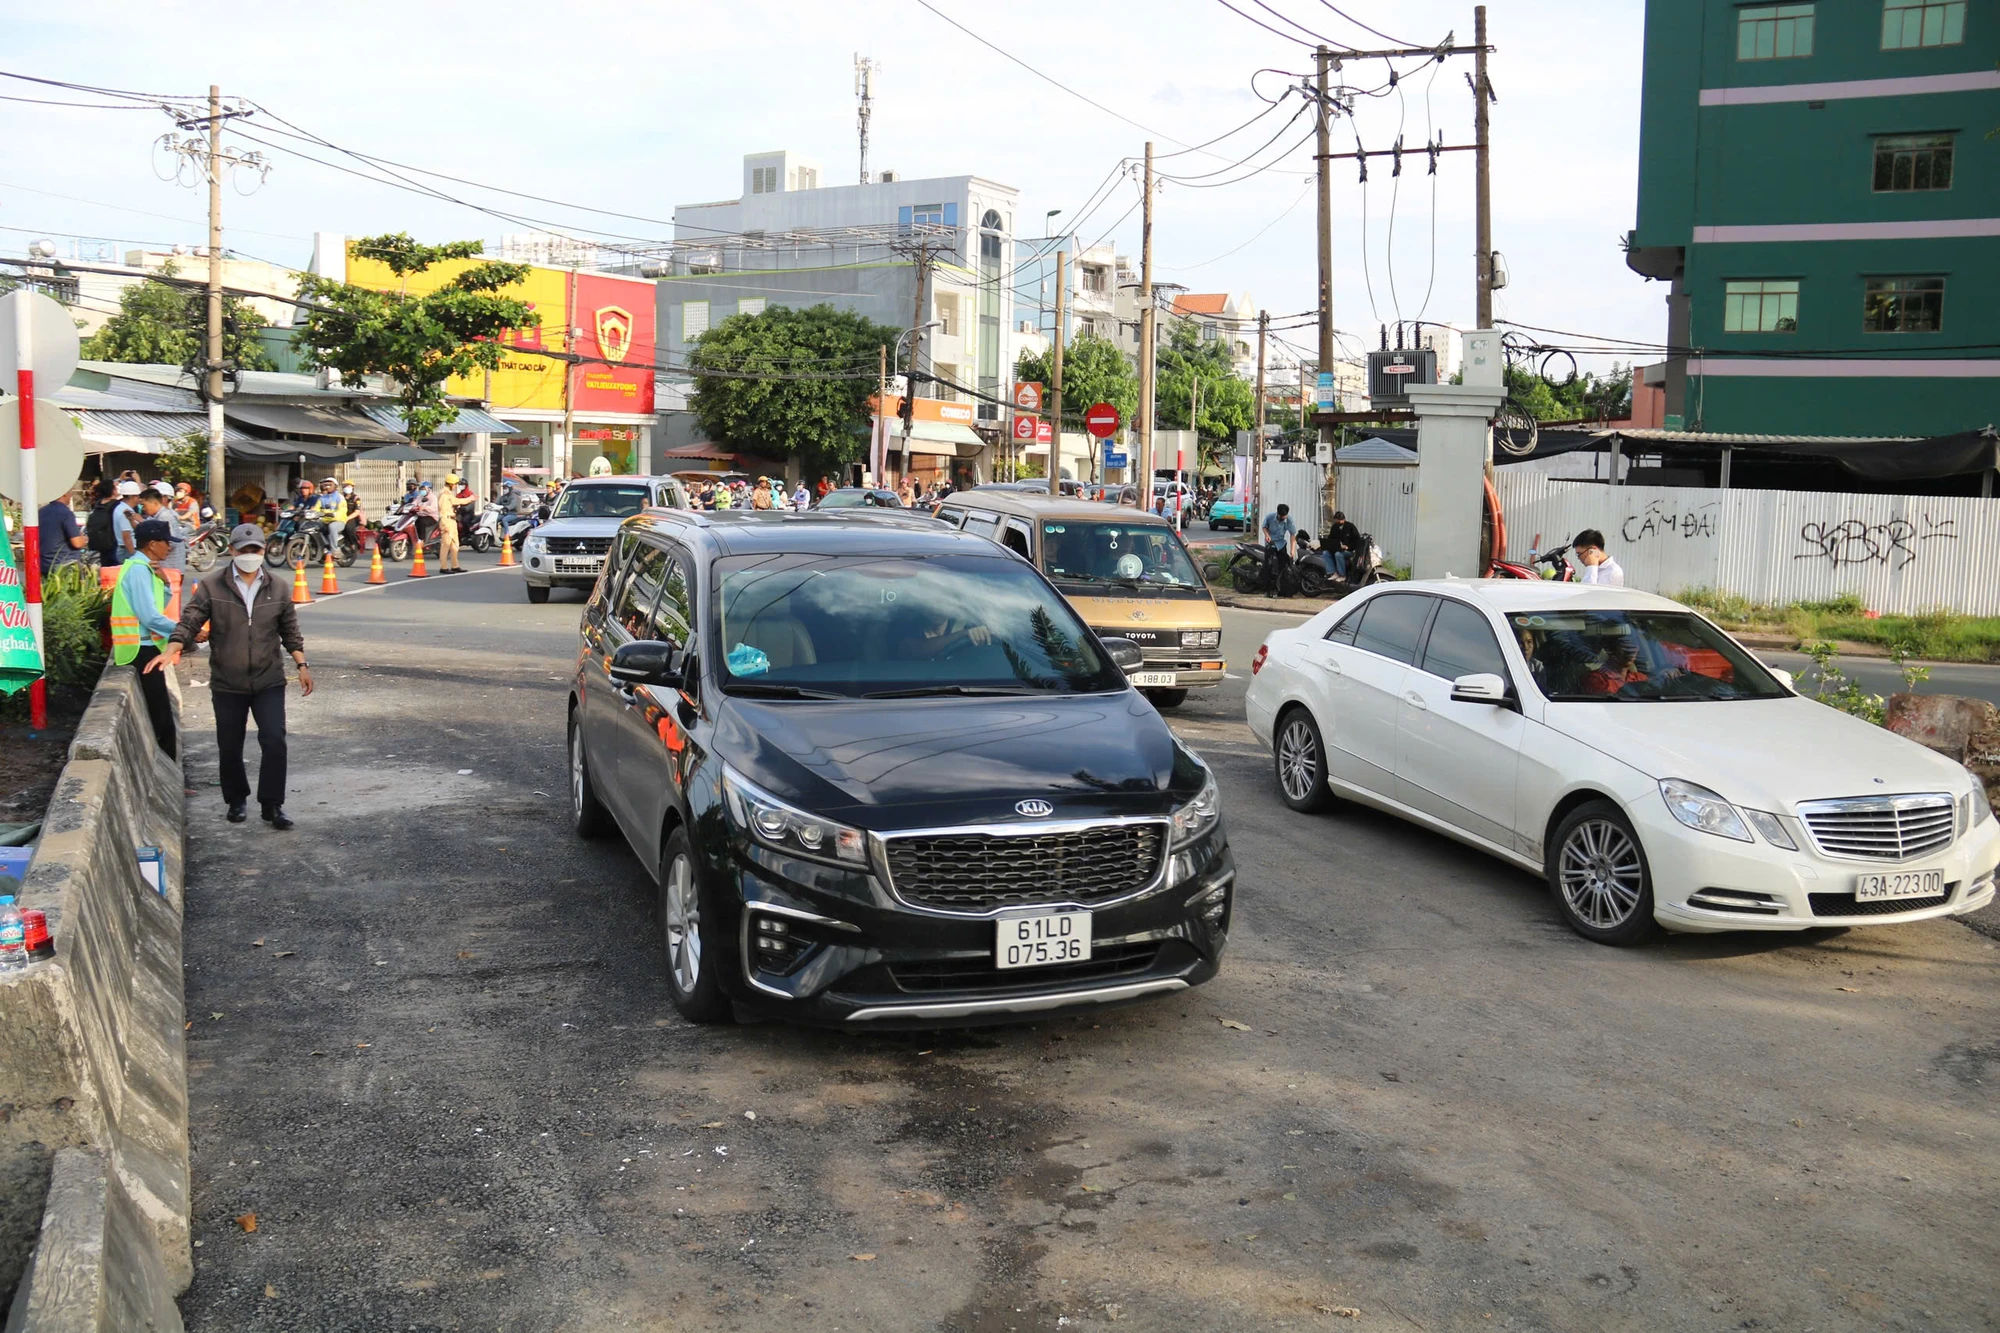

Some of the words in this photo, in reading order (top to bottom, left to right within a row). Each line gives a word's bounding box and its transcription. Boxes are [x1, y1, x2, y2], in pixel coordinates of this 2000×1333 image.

[519, 363, 532, 371] CAO
[941, 406, 970, 419] COMECO
[1021, 802, 1049, 814] KIA
[1860, 872, 1940, 897] 43A-223.00
[1018, 916, 1072, 940] 61LD
[1008, 939, 1081, 965] 075.36
